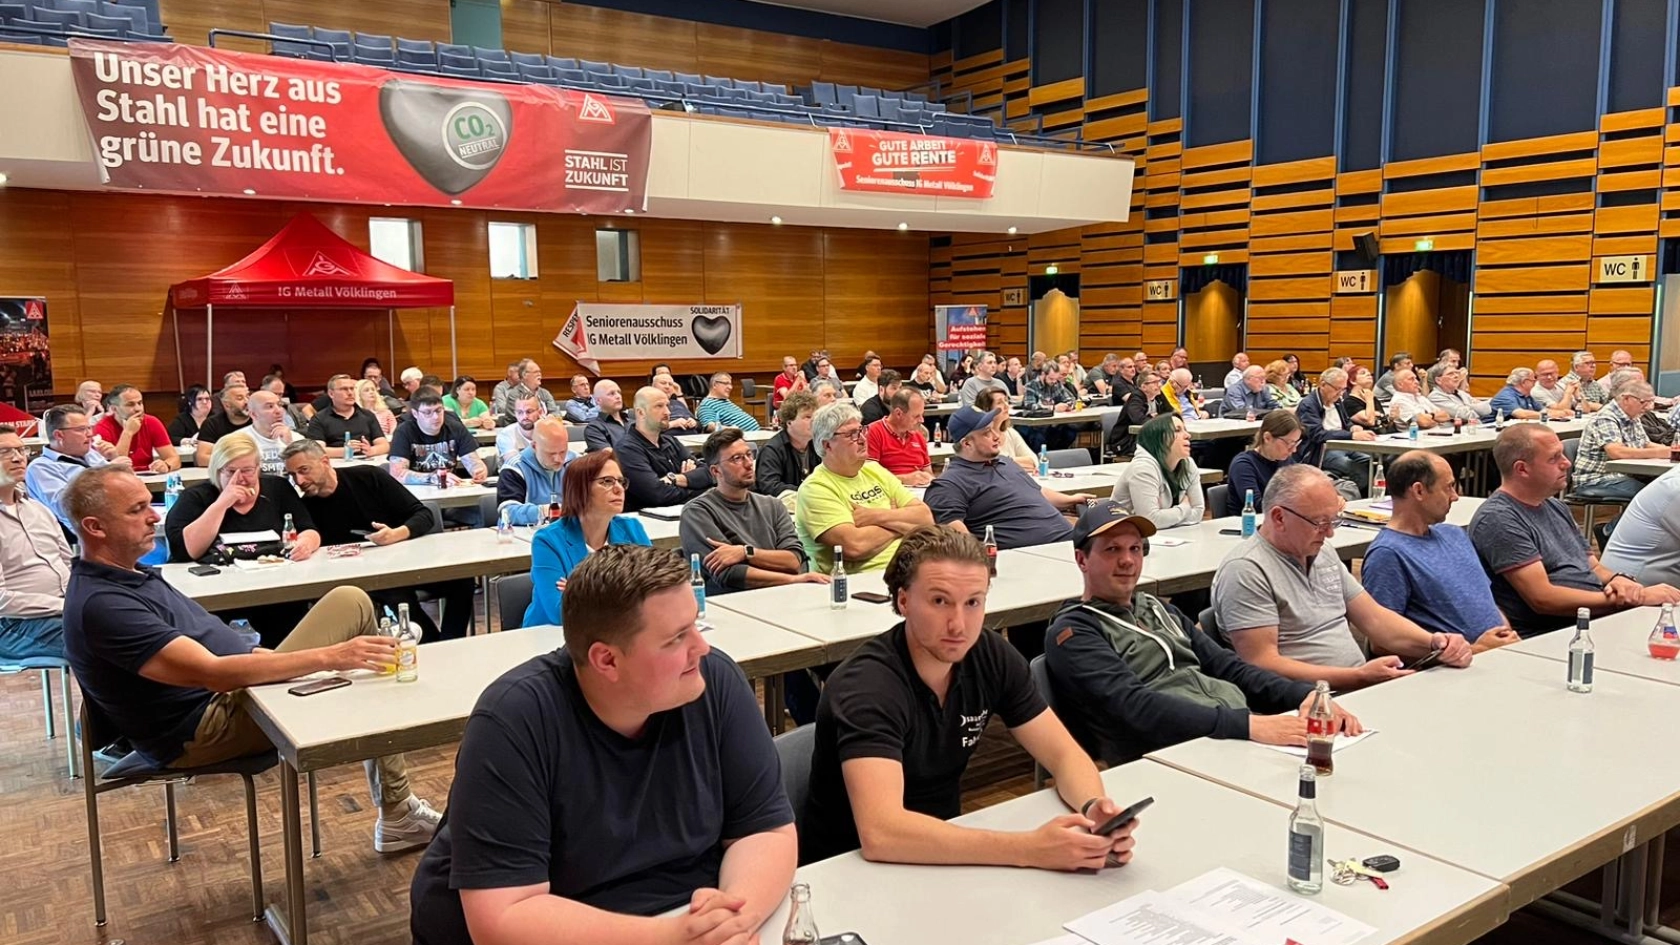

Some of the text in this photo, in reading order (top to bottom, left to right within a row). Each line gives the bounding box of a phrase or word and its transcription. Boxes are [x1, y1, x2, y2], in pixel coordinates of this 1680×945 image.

[94, 52, 342, 104] Unser Herz aus
[97, 89, 327, 138] Stahl hat eine
[100, 131, 345, 175] grüne Zukunft.
[459, 140, 500, 156] NEUTRAL
[879, 140, 946, 151] GUTE ARBEIT
[565, 155, 628, 172] STAHL IST
[872, 151, 956, 166] GUTE RENTE
[565, 170, 628, 186] ZUKUNFT
[1604, 263, 1626, 276] WC
[1340, 276, 1357, 287] WC
[295, 286, 333, 297] Metall
[335, 286, 397, 300] Völklingen
[1149, 285, 1162, 296] WC
[586, 315, 683, 328] Seniorenausschuss
[599, 333, 631, 345] Metall
[633, 333, 688, 348] Völklingen
